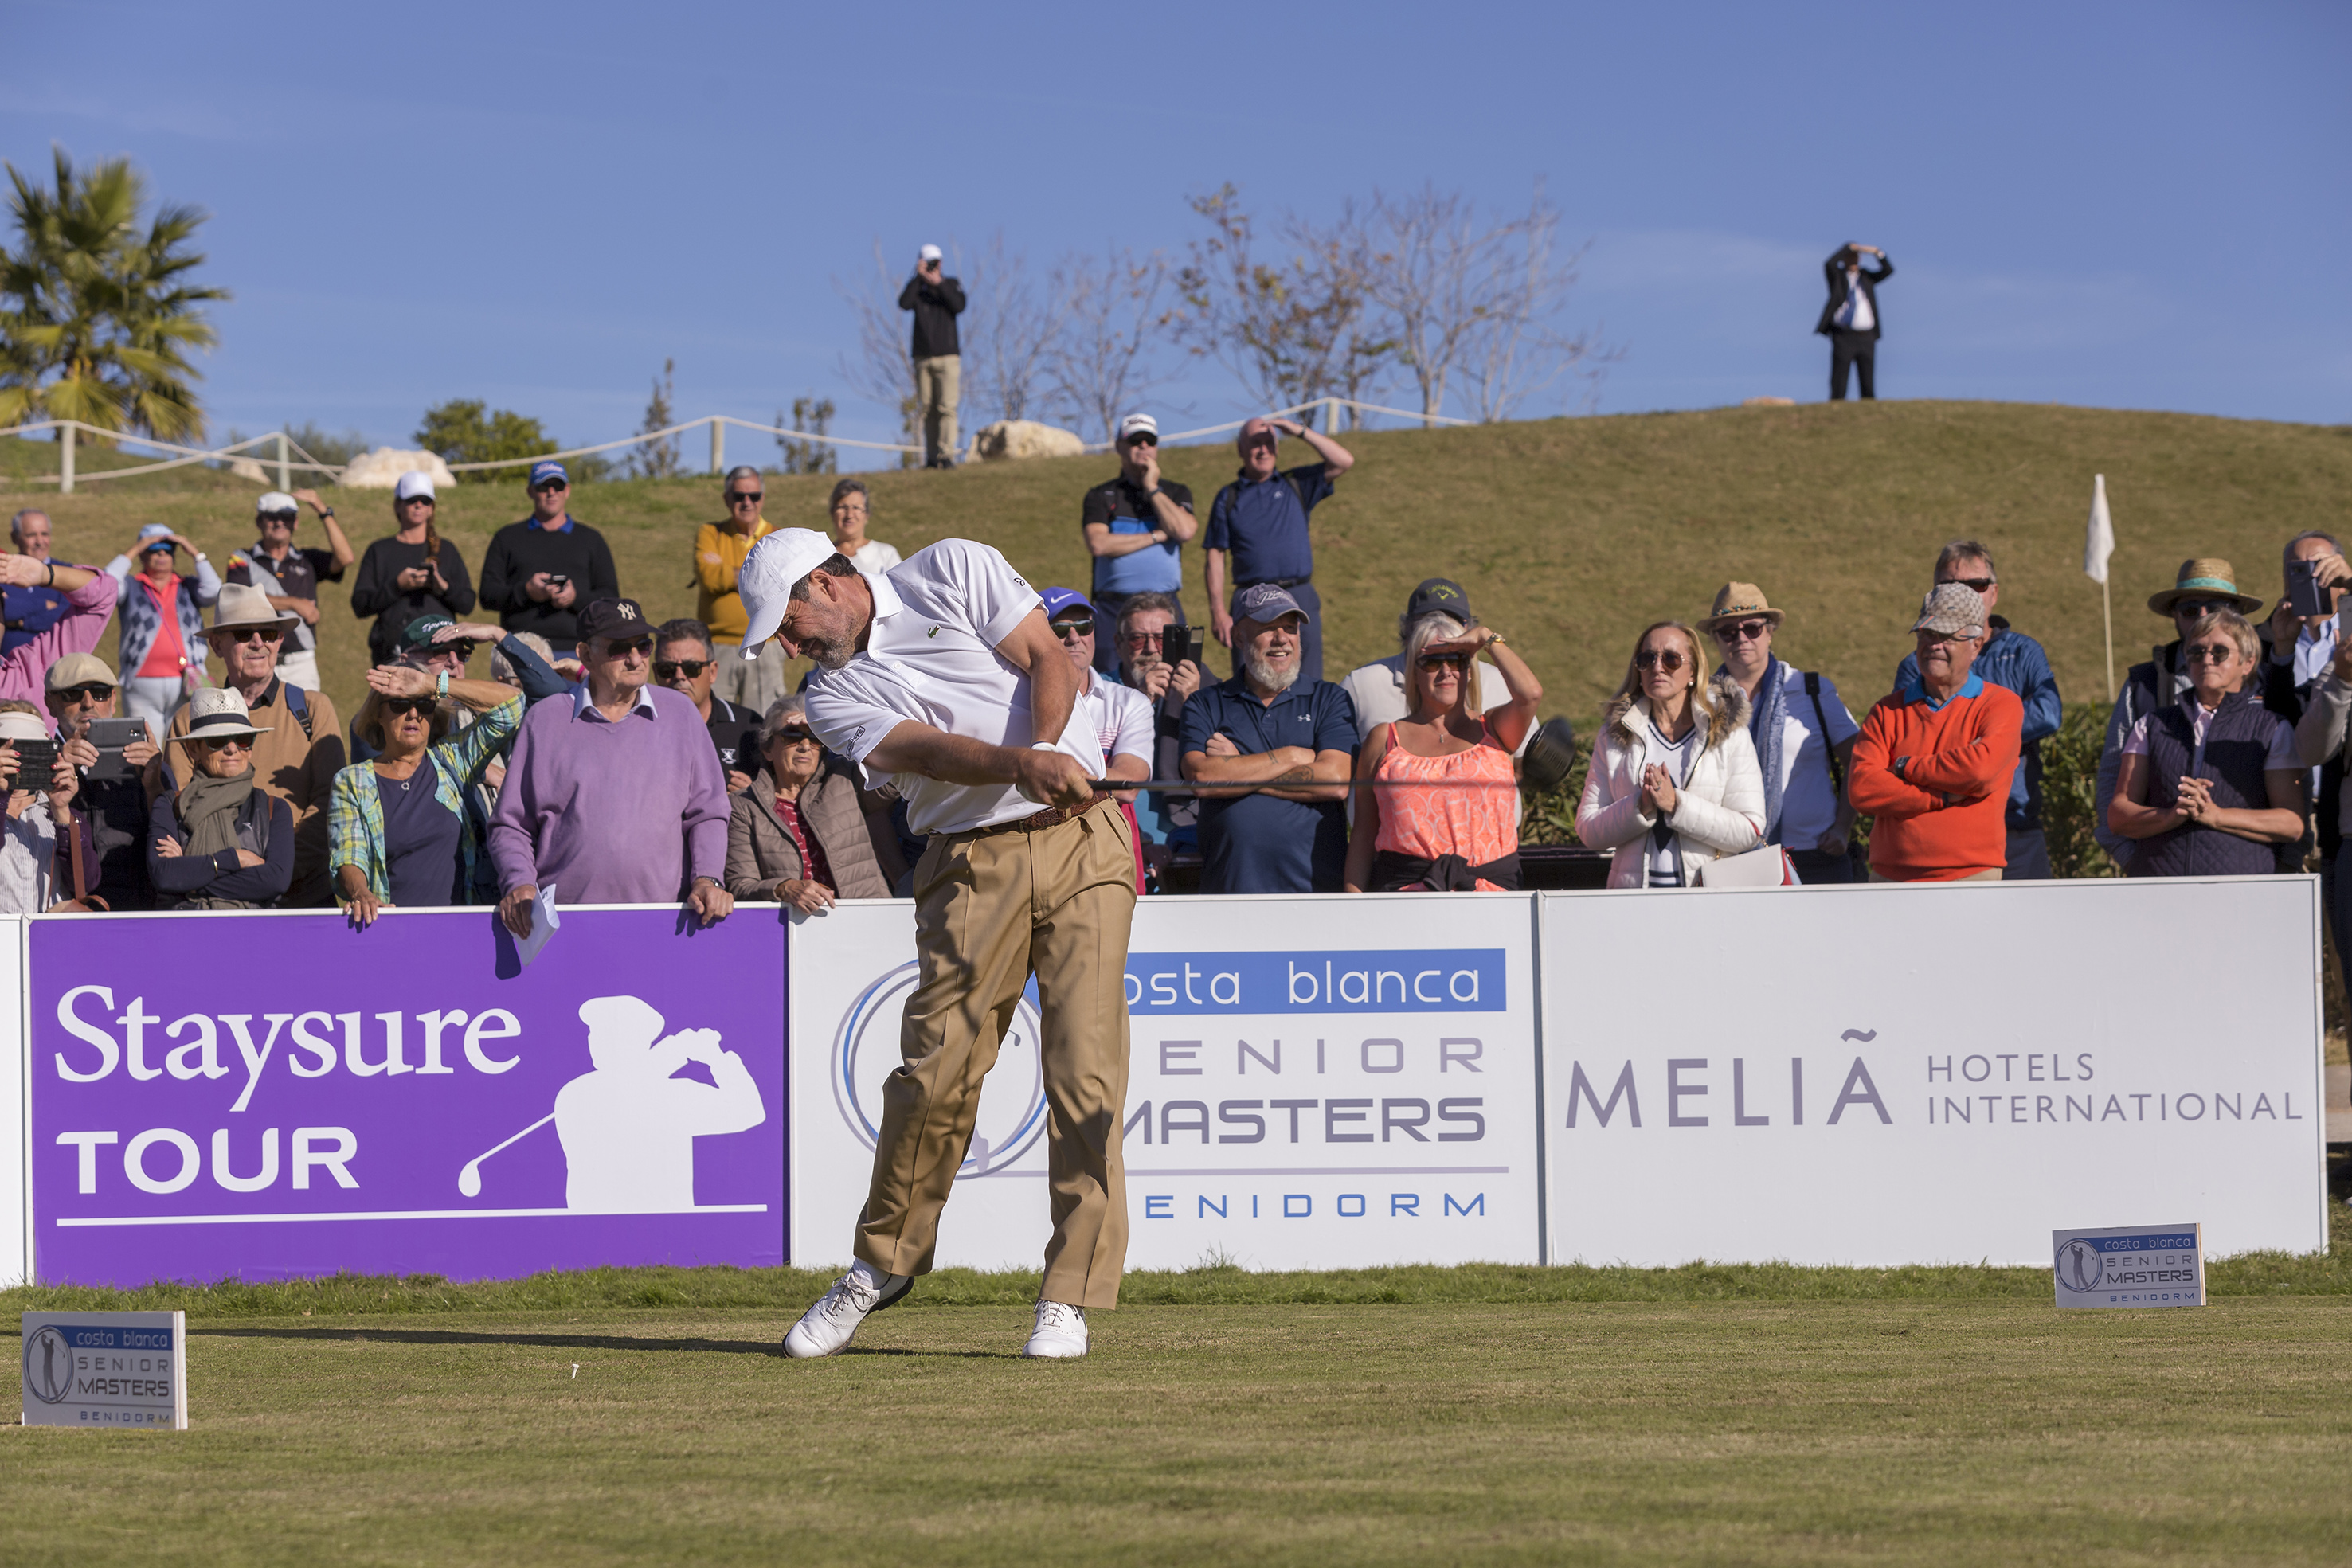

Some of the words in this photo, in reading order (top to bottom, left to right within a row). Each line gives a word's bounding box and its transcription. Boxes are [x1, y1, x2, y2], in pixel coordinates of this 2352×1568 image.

[1123, 963, 1240, 1005] osta
[1289, 960, 1479, 1003] blanca
[55, 985, 522, 1112] Staysure
[1160, 1038, 1484, 1075] ENIOR
[1927, 1053, 2094, 1083] HOTELS
[1928, 1092, 2303, 1124] INTERNATIONAL
[56, 1127, 361, 1194] TOUR
[1145, 1192, 1485, 1219] ENIDORM
[2105, 1238, 2140, 1250] costa
[2149, 1237, 2190, 1249] blanca
[2107, 1255, 2192, 1268] SENIOR
[2107, 1269, 2193, 1285] MASTERS
[2110, 1293, 2194, 1302] BENIDORM
[76, 1329, 115, 1346] costa
[123, 1330, 168, 1348] blanca
[78, 1356, 169, 1373] SENIOR
[78, 1378, 169, 1397] MASTERS
[80, 1410, 170, 1424] BENIDORM
